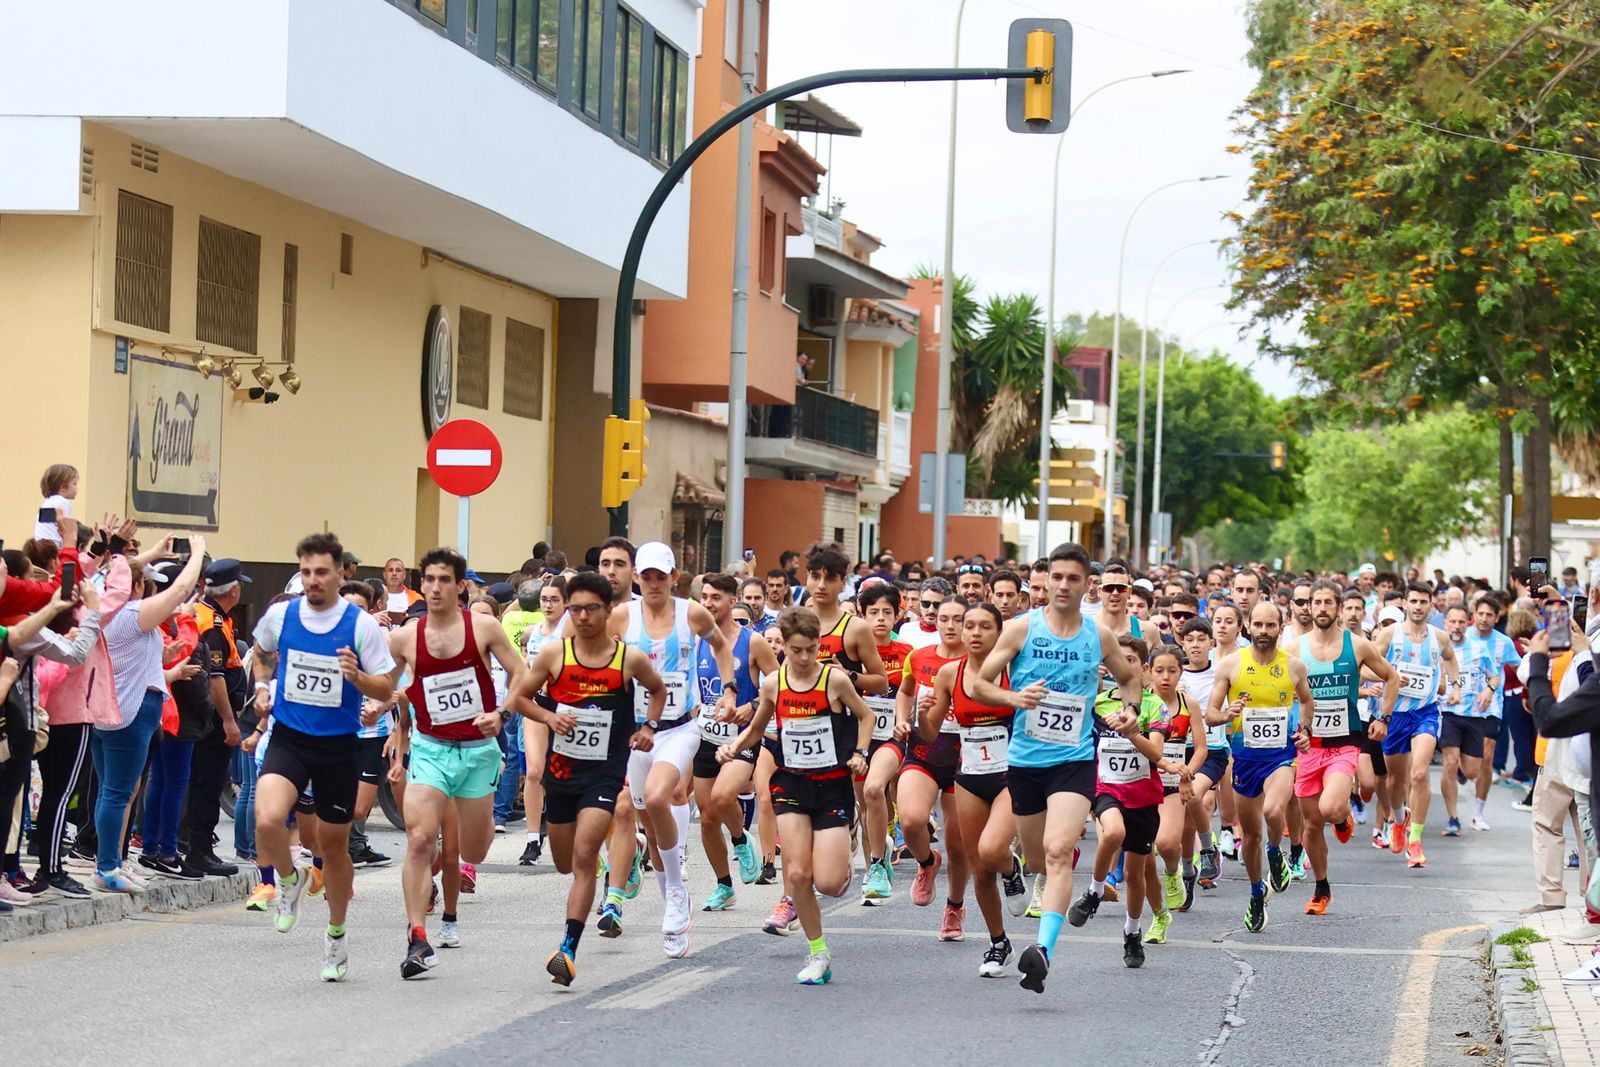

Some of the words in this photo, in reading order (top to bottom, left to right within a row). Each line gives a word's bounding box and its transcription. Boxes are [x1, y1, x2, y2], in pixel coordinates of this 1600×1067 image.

[150, 391, 200, 484] Grand
[1032, 648, 1080, 663] nerja
[296, 673, 332, 693] 879
[579, 682, 609, 693] Bahía
[1308, 674, 1351, 687] WATT
[437, 689, 473, 711] 504
[789, 706, 817, 715] Bahía
[1037, 711, 1074, 732] 528
[1315, 714, 1342, 728] 778
[564, 726, 600, 747] 926
[704, 721, 730, 738] 601
[1252, 723, 1281, 738] 863
[791, 738, 825, 756] 751
[980, 745, 991, 761] 1
[1109, 757, 1141, 772] 674
